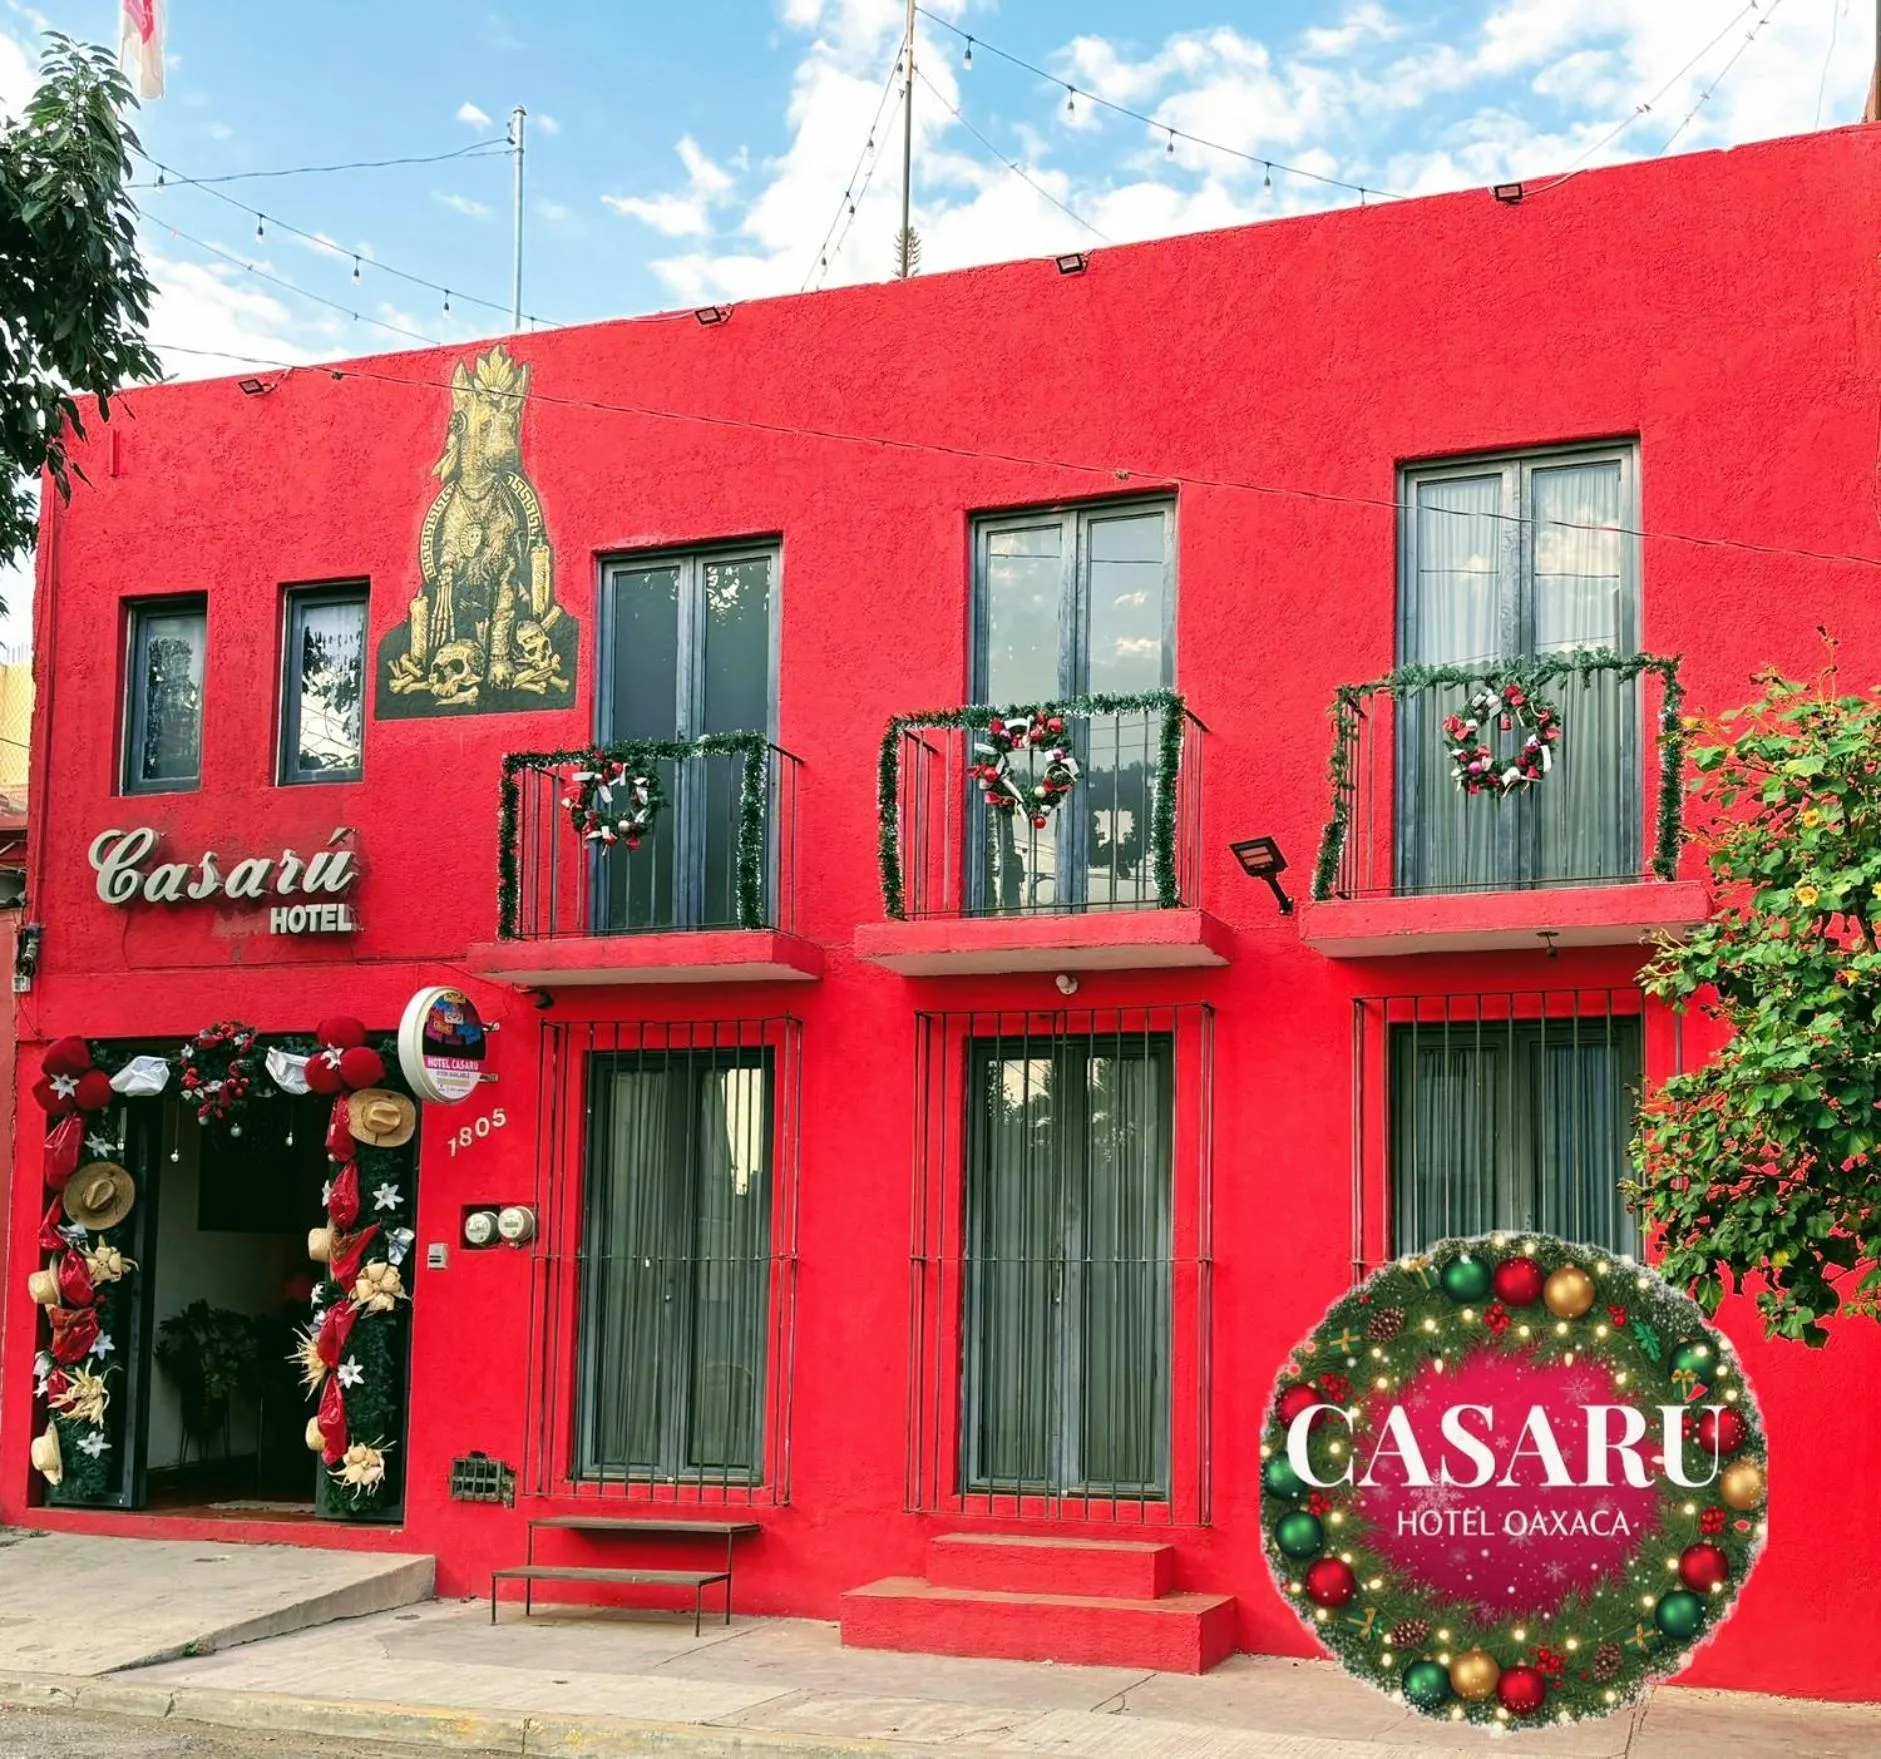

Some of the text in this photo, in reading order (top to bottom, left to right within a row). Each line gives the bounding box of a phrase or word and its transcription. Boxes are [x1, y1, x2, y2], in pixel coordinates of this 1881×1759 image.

[88, 826, 359, 905] Casarú
[270, 904, 353, 935] HOTEL
[427, 1056, 451, 1069] HOTEL
[447, 1108, 507, 1158] 1805
